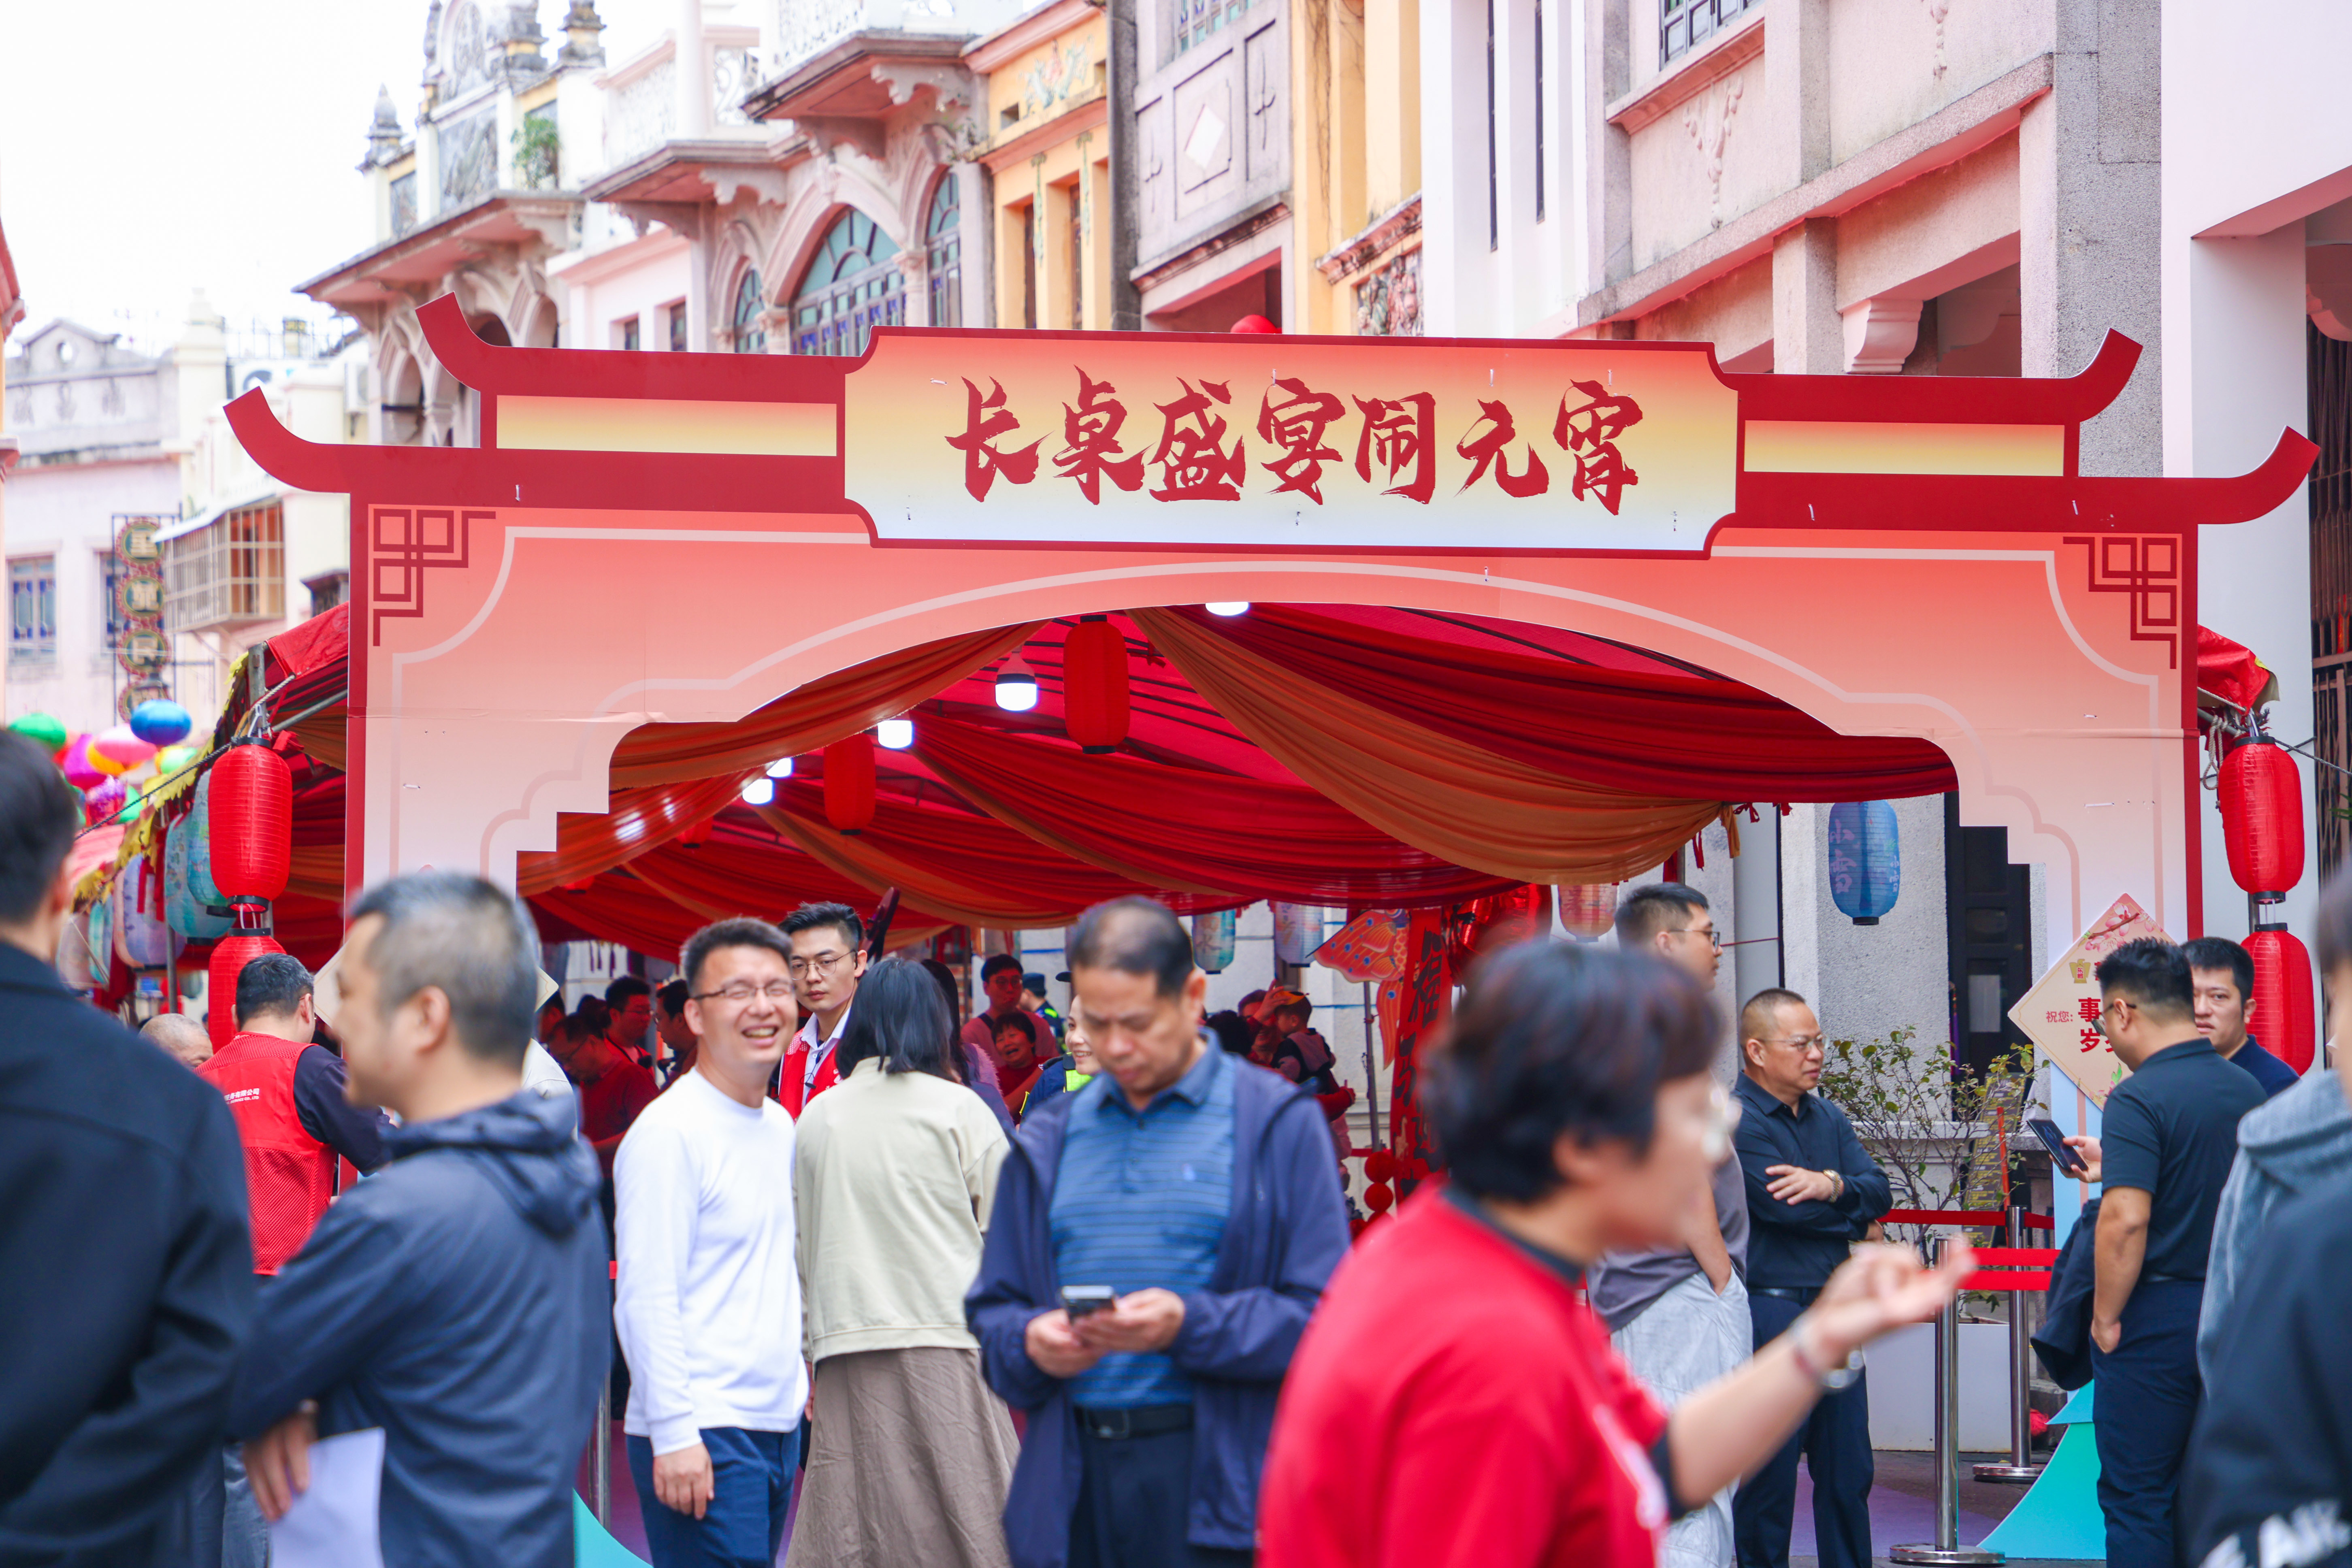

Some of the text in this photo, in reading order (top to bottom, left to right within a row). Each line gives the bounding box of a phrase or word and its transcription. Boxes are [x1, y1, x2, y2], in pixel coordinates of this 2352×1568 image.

[945, 364, 1643, 515] 长桌盛宴闹元宵
[2046, 1010, 2073, 1023] 祝您：
[2080, 1028, 2114, 1053] 岁
